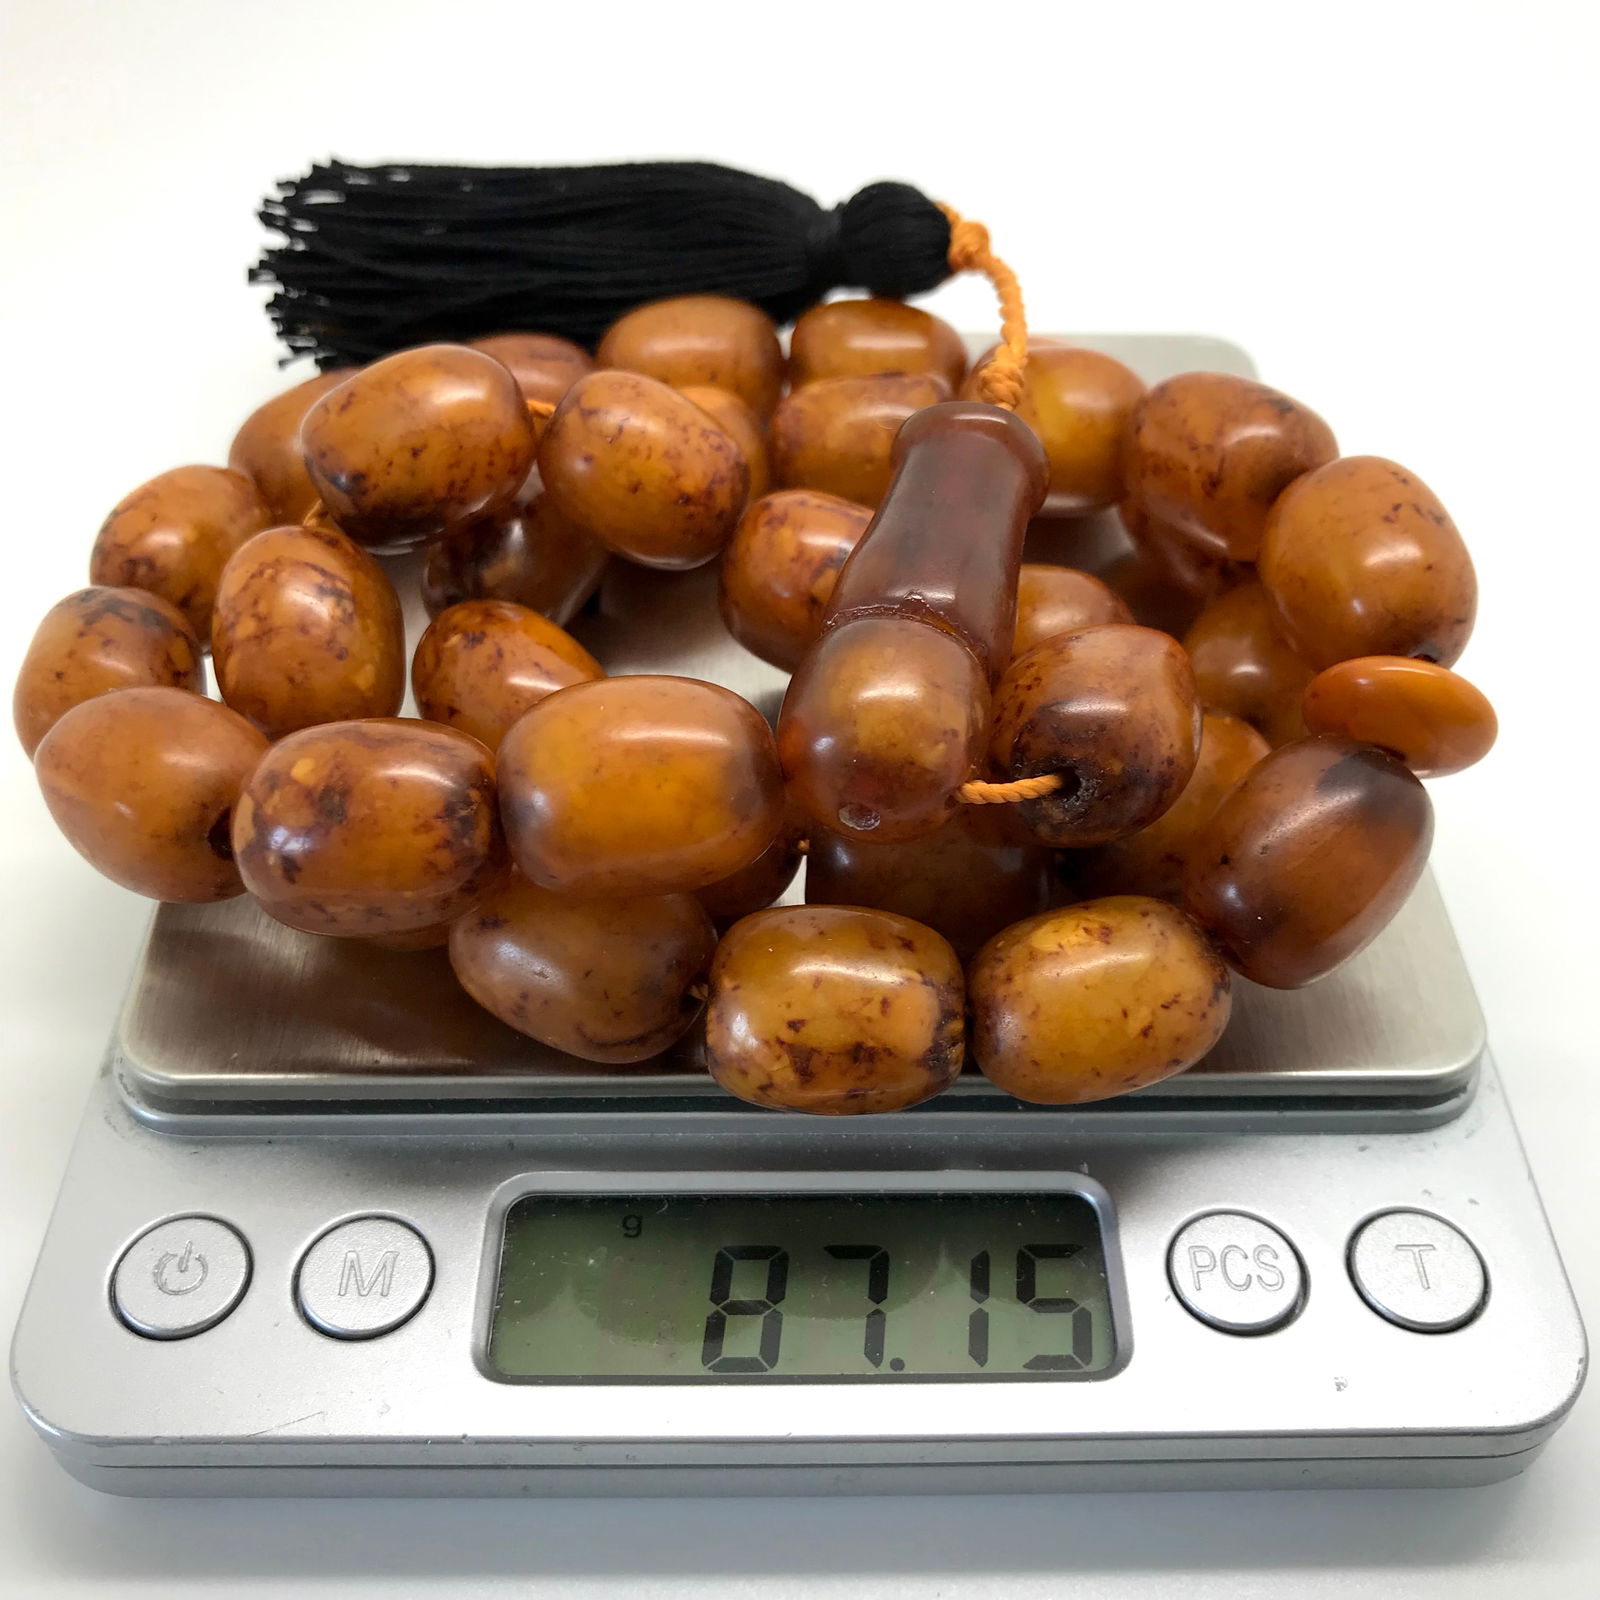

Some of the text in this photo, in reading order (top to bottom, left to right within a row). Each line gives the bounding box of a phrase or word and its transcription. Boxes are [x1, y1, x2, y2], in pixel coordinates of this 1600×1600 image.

[621, 1213, 643, 1239] g
[338, 1249, 401, 1297] M
[1187, 1243, 1286, 1292] PCS
[1394, 1243, 1437, 1290] T
[701, 1244, 1093, 1373] 87.15
